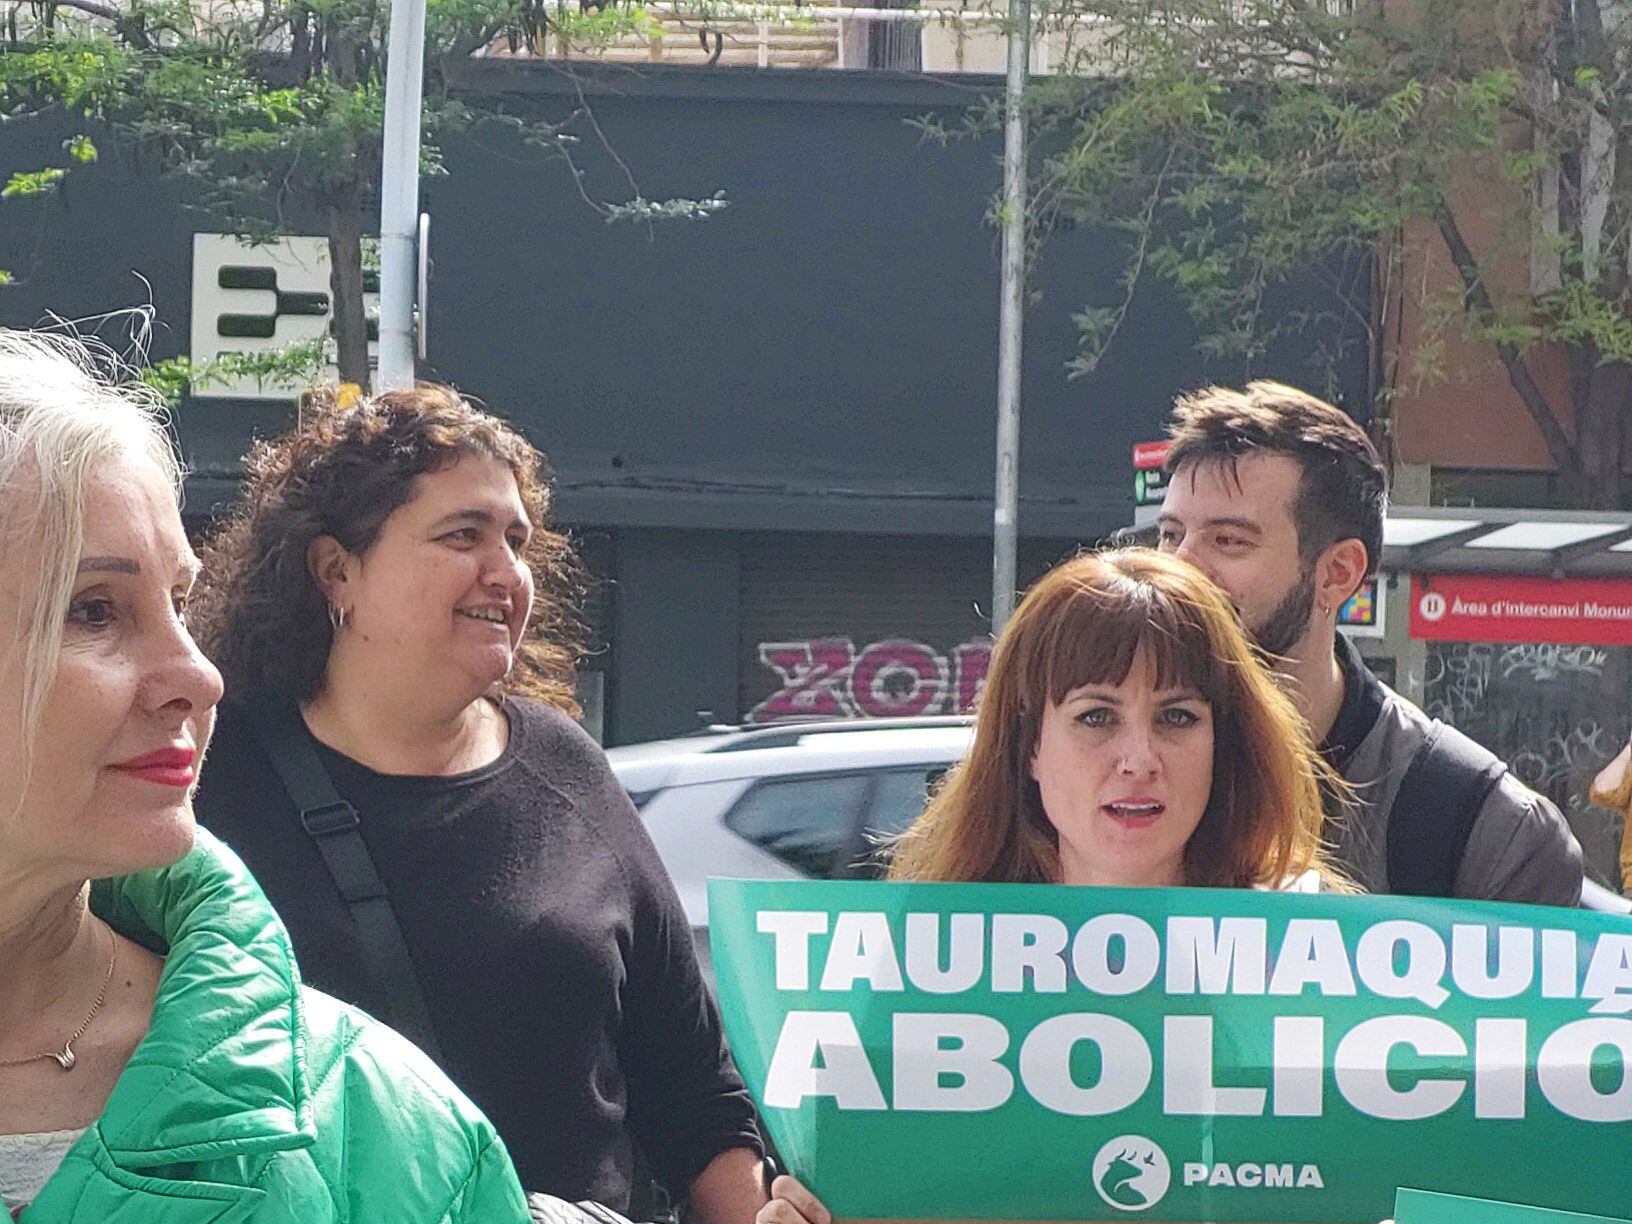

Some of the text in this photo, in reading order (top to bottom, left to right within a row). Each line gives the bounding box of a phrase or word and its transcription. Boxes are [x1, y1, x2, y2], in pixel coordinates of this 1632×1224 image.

[1491, 599, 1580, 618] d'intercanvi
[1584, 601, 1632, 619] Monu
[756, 910, 1632, 1010] TAUROMAQUIA
[1181, 1160, 1325, 1189] PACMA
